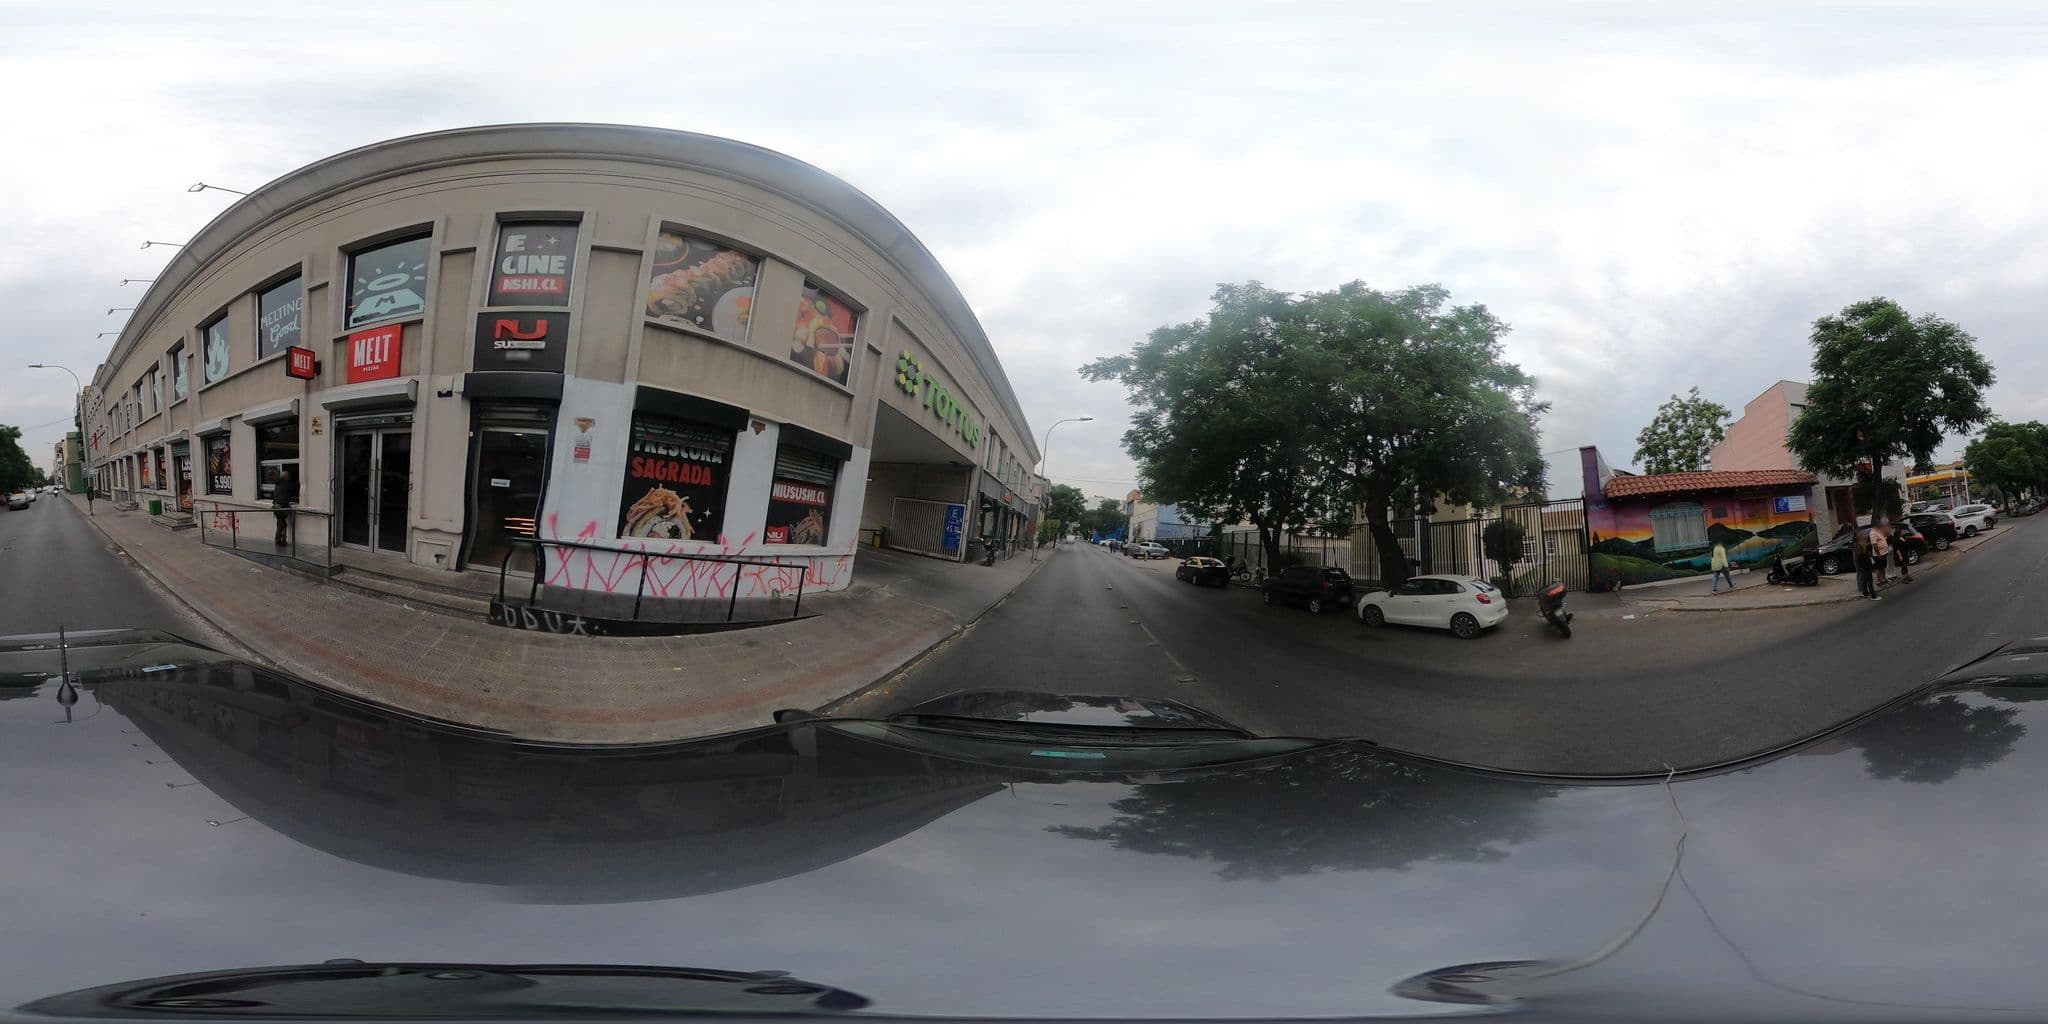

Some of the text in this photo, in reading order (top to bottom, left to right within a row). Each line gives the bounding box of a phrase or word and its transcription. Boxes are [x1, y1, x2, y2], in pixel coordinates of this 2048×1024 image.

[261, 296, 304, 329] MELTING
[270, 314, 301, 348] Good
[294, 352, 311, 370] MELT
[354, 333, 392, 367] MELT
[924, 373, 982, 449] TOTTUS
[214, 475, 232, 489] 5.990
[631, 456, 712, 487] SAGRADA
[772, 483, 825, 504] NIUSUSHI.CL
